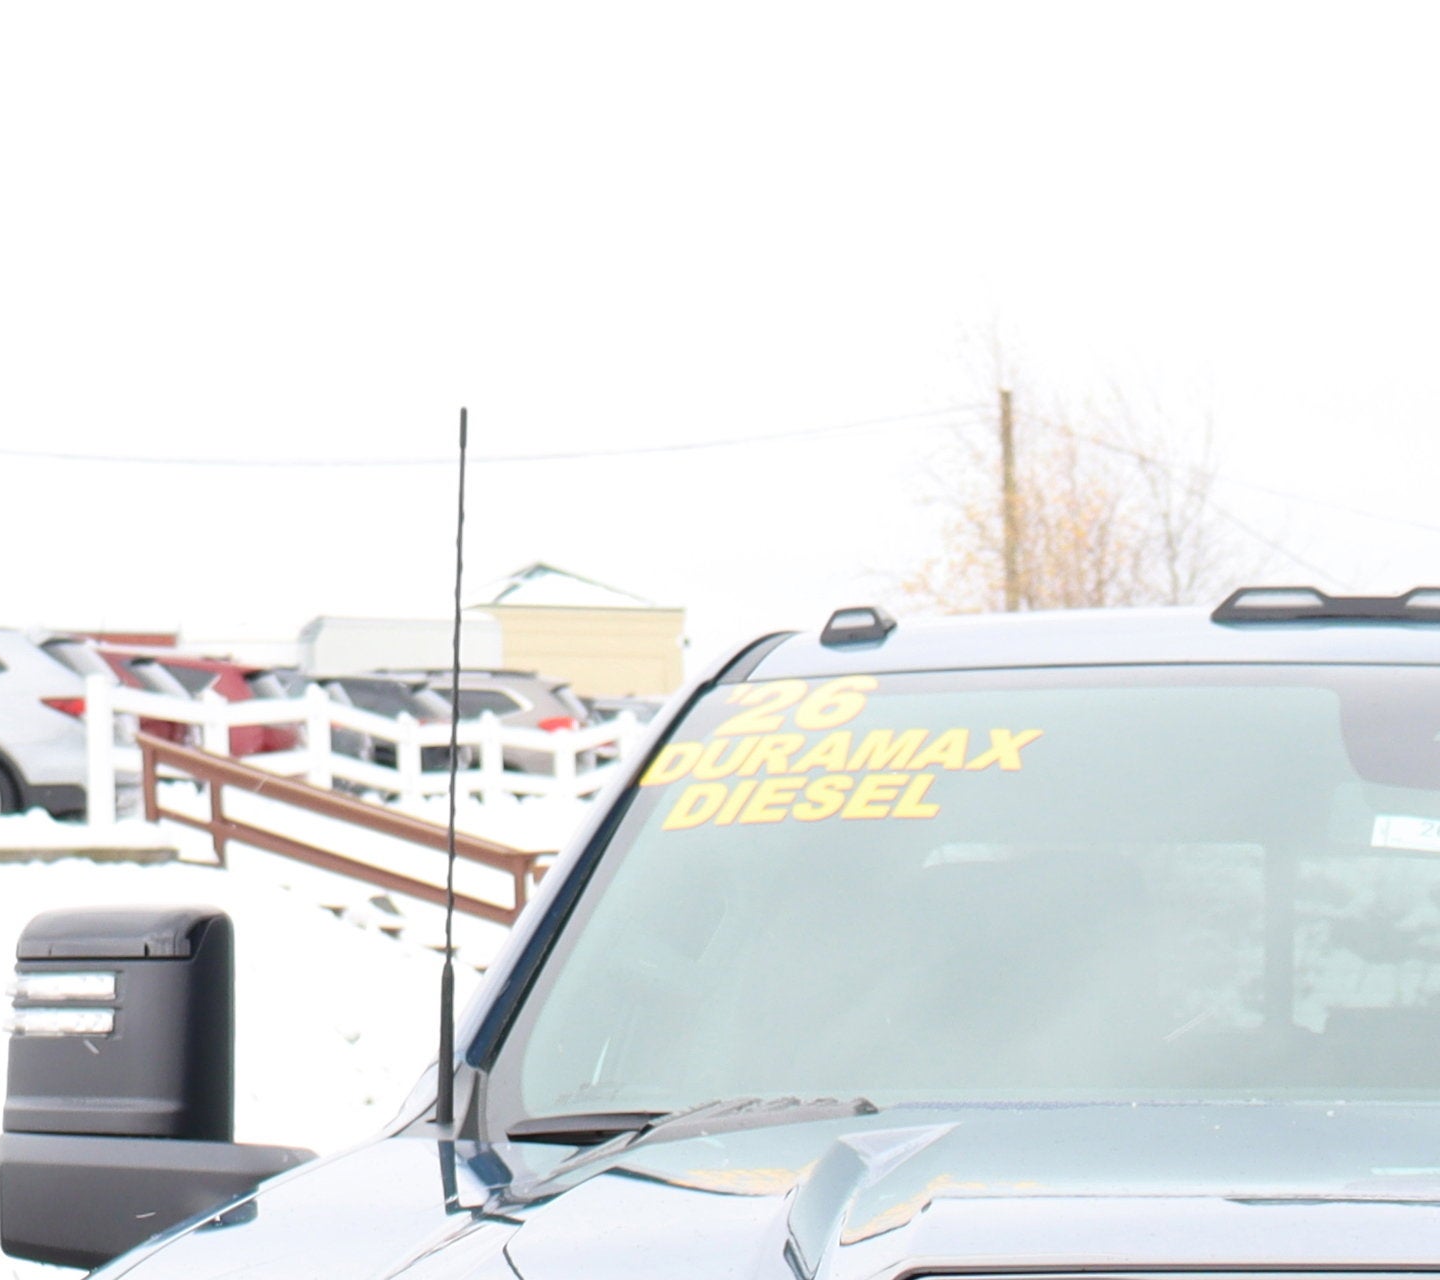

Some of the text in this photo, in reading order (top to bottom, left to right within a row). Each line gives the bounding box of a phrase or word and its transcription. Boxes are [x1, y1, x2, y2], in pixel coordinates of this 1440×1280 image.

[714, 675, 878, 737] '26
[640, 728, 1044, 787] DURAMAX
[662, 773, 941, 832] DIESEL
